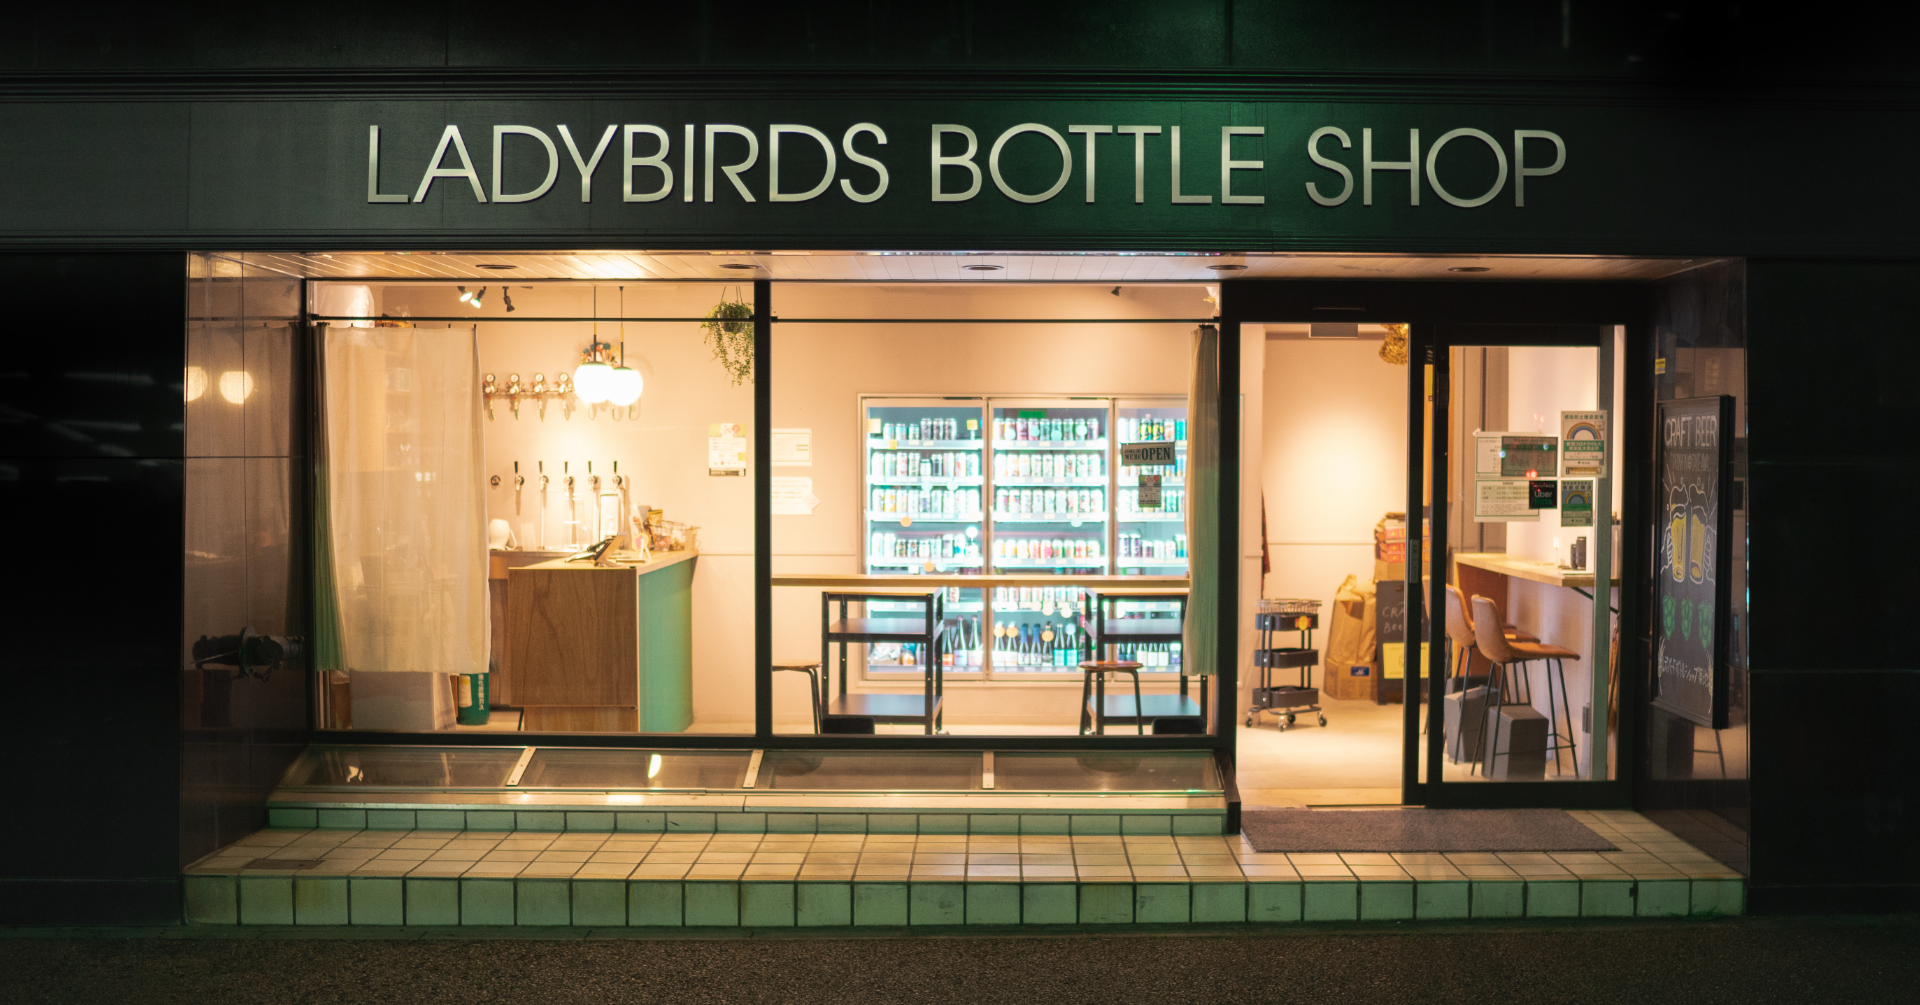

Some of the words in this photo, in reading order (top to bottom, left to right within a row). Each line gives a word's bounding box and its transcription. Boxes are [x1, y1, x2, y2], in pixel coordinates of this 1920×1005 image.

[366, 122, 890, 204] LADYBIRDS
[931, 122, 1266, 205] BOTTLE
[1305, 126, 1567, 208] SHOP
[1664, 416, 1692, 447] CRAFT
[1695, 415, 1717, 447] BEER
[1141, 447, 1171, 461] OPEN
[1382, 605, 1404, 618] CRA
